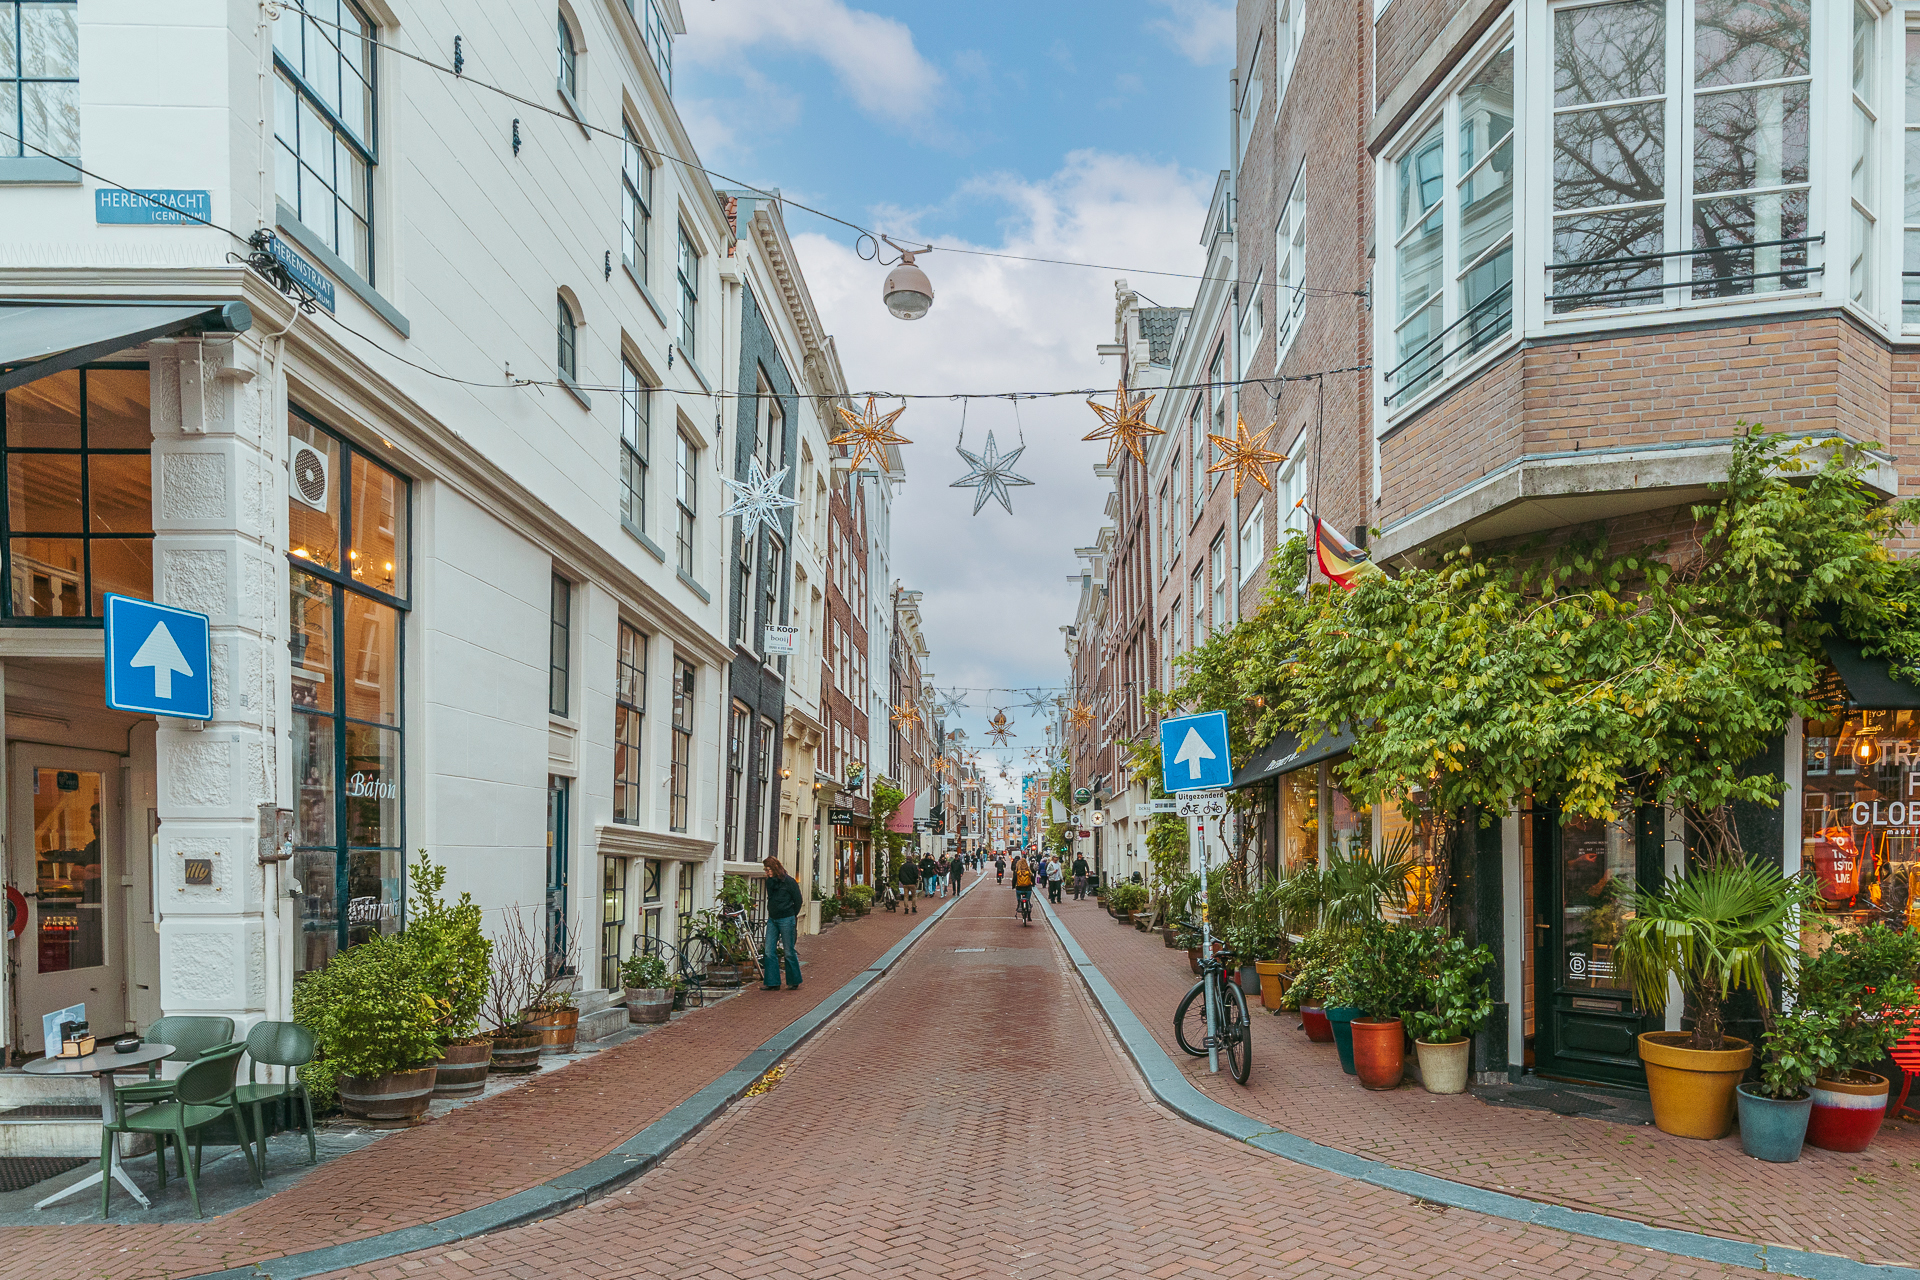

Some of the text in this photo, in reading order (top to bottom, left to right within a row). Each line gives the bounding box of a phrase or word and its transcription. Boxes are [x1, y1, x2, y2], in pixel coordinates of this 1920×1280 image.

[101, 193, 205, 208] HERENGRACHT
[151, 211, 206, 220] (CENTRUM)
[273, 239, 331, 296] HERENSTRAAT
[777, 626, 798, 634] KOOP
[351, 771, 396, 801] Bâton
[1179, 792, 1224, 801] Uitgezonderd
[1831, 837, 1845, 846] TO
[1834, 861, 1853, 871] IS TO
[186, 863, 209, 881] illy
